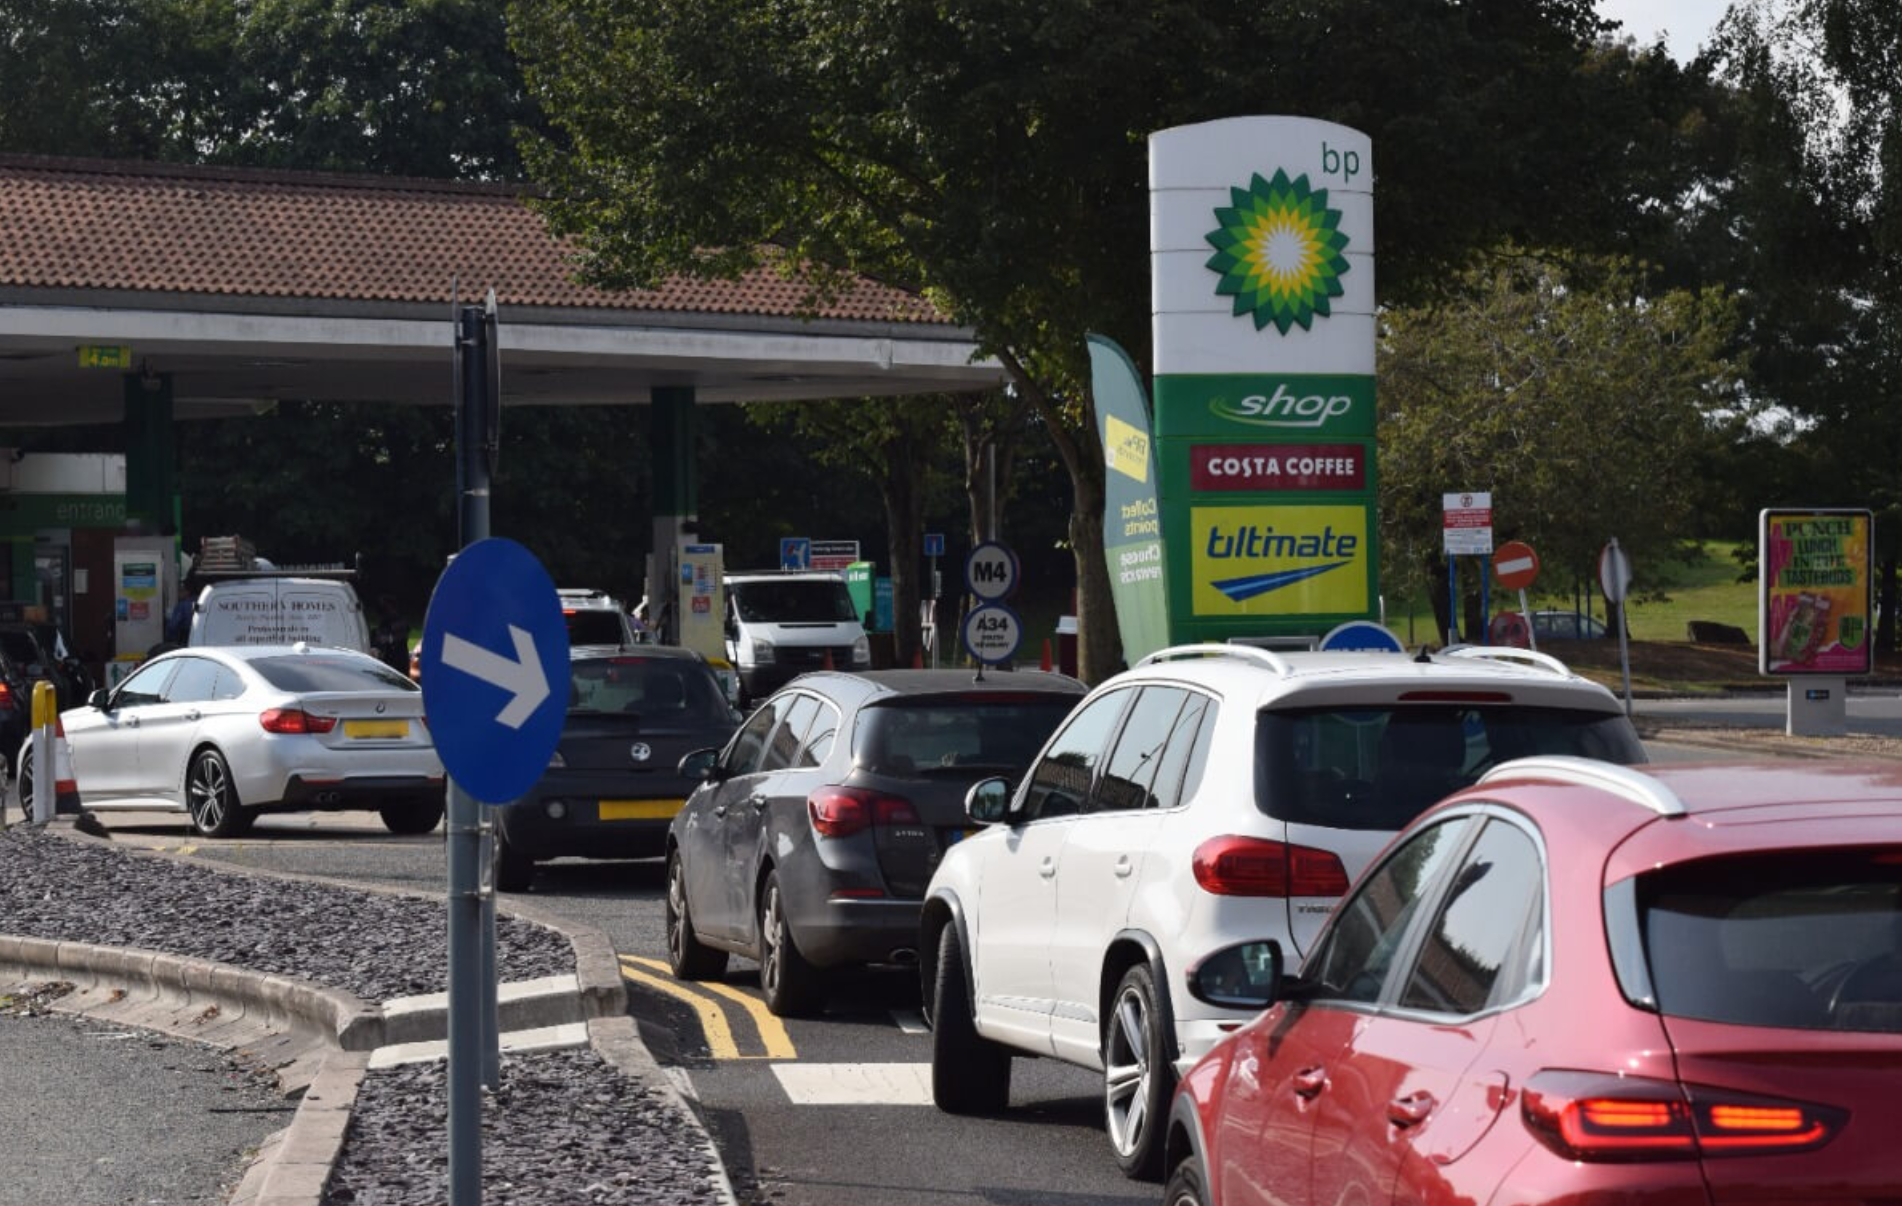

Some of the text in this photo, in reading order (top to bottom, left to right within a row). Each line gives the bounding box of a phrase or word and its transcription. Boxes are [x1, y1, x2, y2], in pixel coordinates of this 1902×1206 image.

[1322, 141, 1360, 184] bp
[1241, 384, 1352, 427] shop
[1208, 457, 1355, 478] COSTA COFFEE
[57, 503, 127, 520] entranc
[1785, 521, 1852, 537] PUNCH
[1207, 526, 1357, 559] ultimate
[1797, 538, 1839, 553] LUNCH
[974, 561, 1007, 582] M4
[218, 601, 336, 612] SOUTHERN HOMES
[976, 617, 1009, 632] A34
